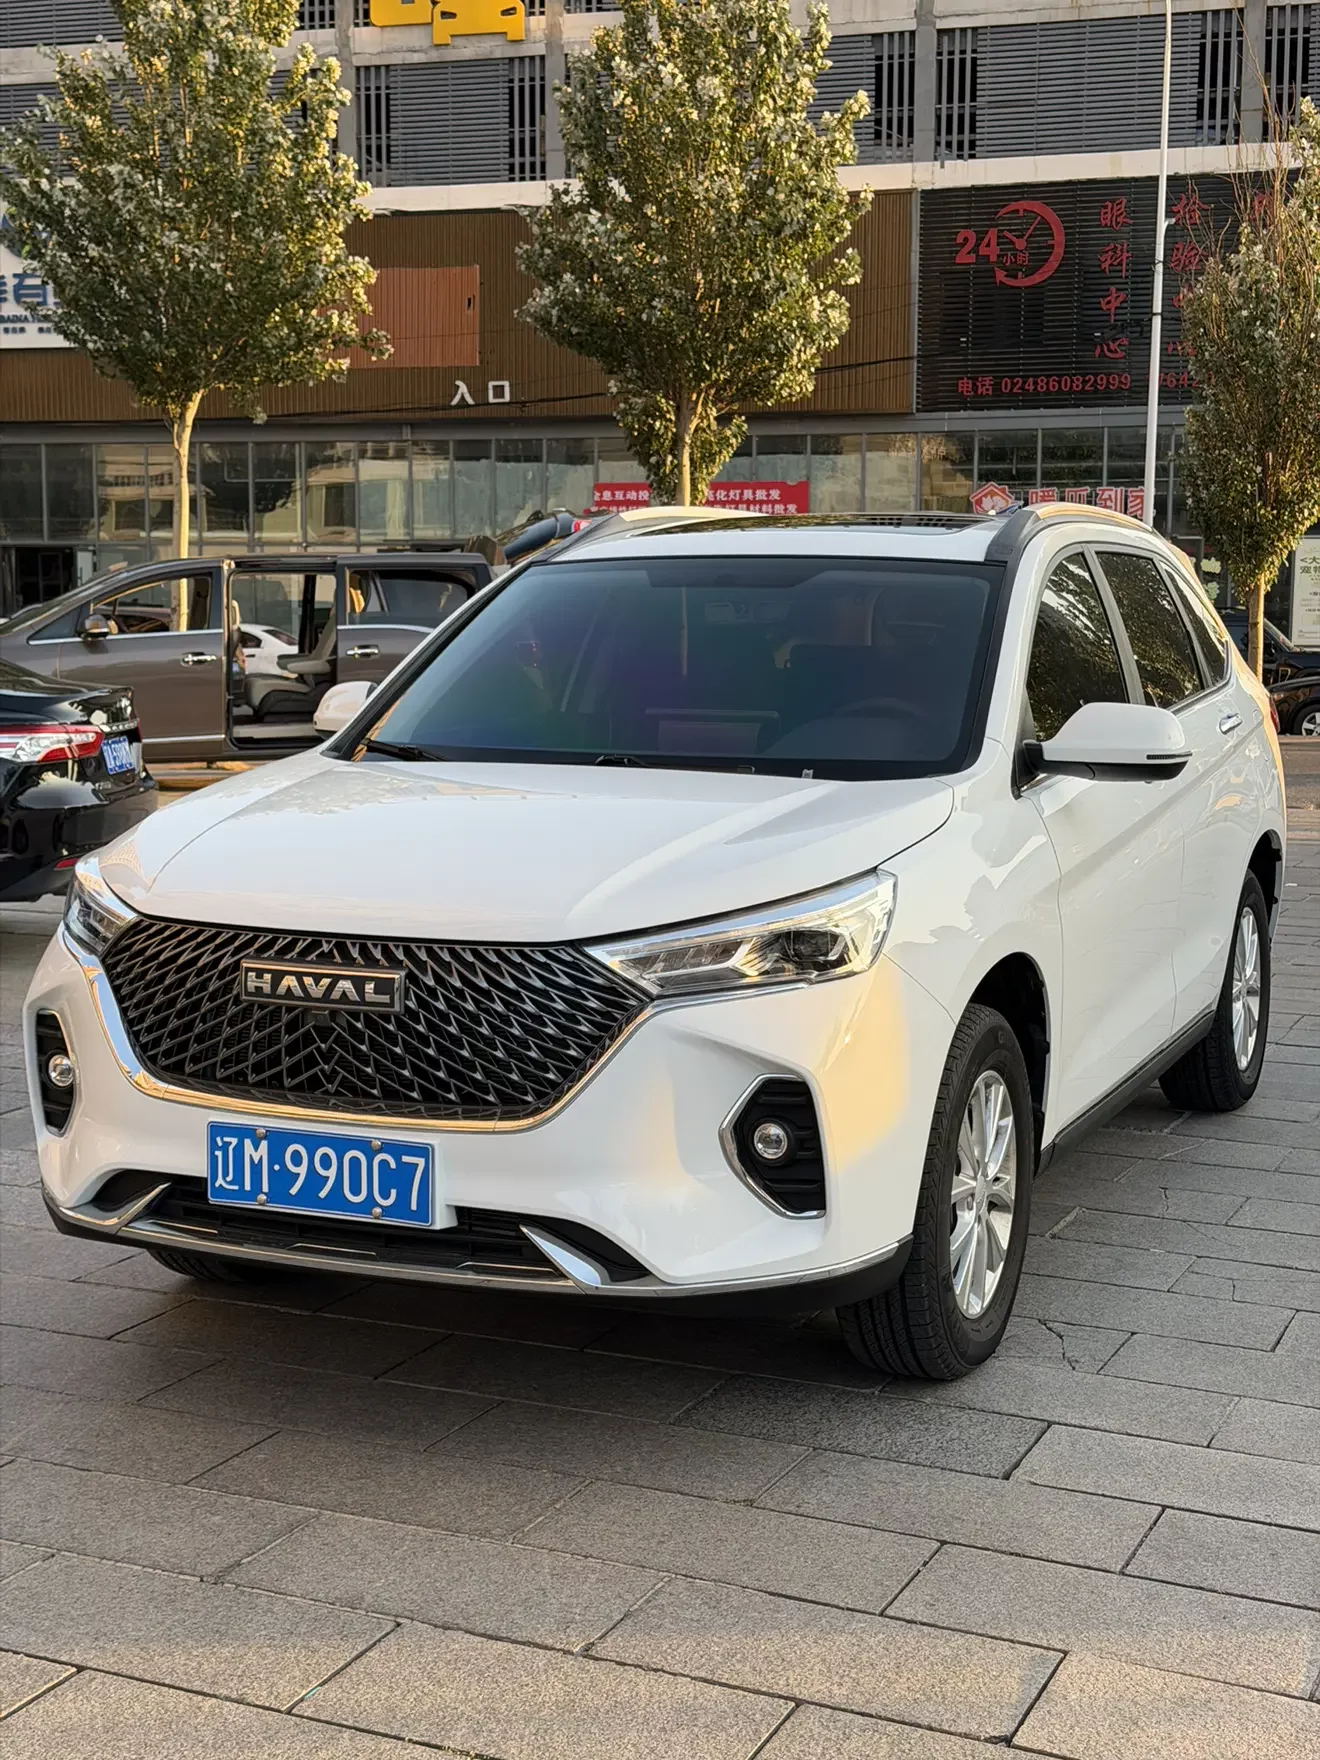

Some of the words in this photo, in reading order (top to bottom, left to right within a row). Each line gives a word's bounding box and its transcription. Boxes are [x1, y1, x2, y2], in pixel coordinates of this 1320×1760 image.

[954, 228, 1000, 264] 24
[1002, 253, 1030, 267] 小时
[1093, 197, 1132, 359] 眼科中心
[450, 380, 511, 405] 入口
[957, 376, 994, 396] 电话
[1001, 373, 1132, 394] 02486082999
[247, 971, 391, 1003] HAVAL
[213, 1136, 427, 1212] 辽M·990C7
